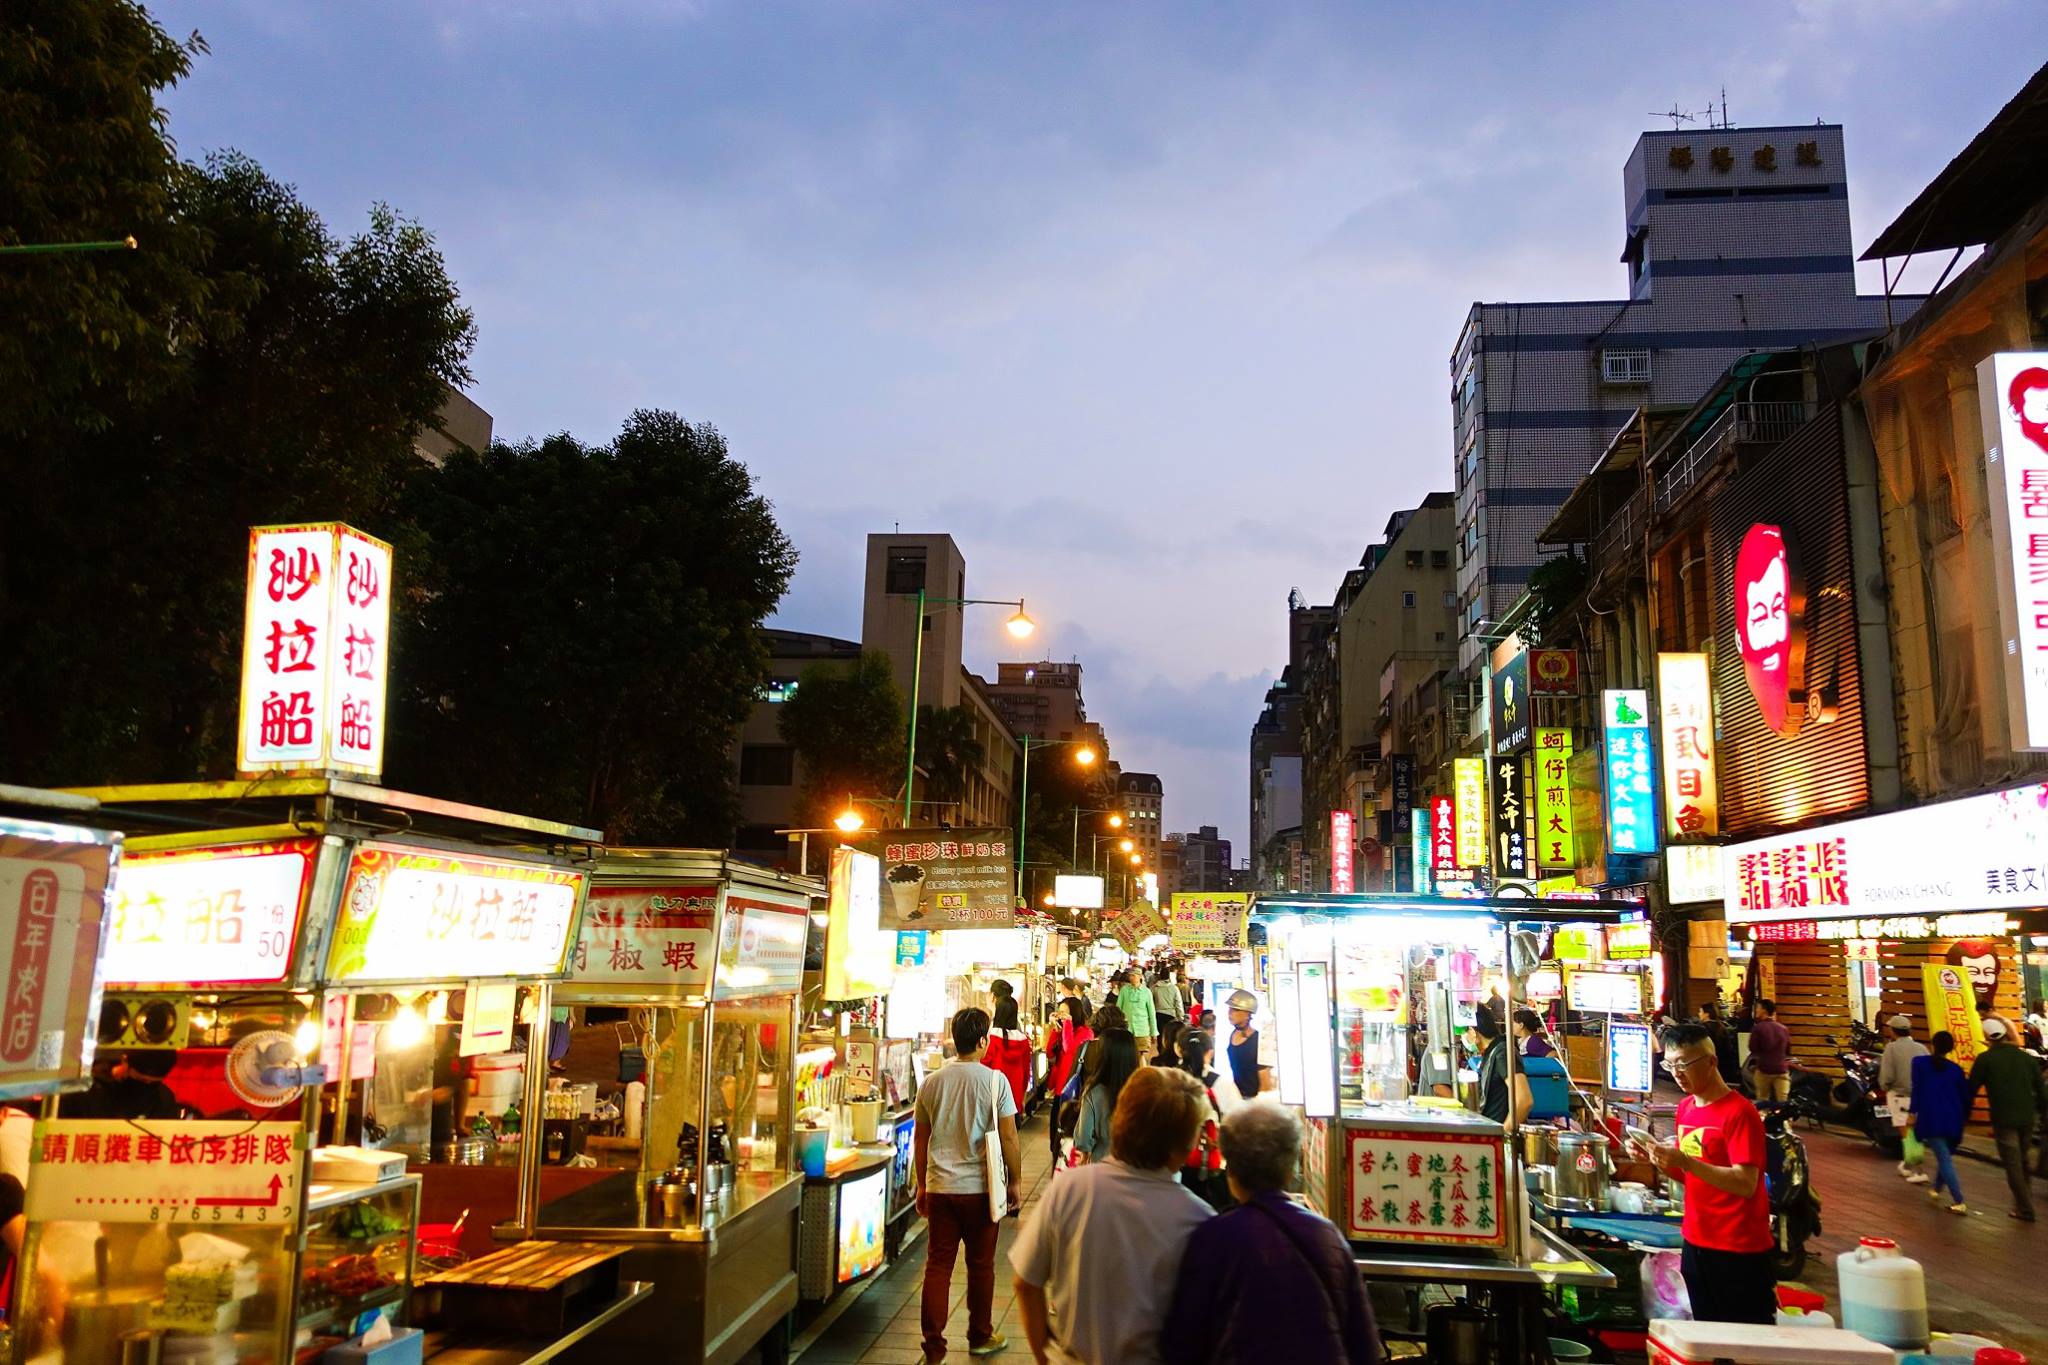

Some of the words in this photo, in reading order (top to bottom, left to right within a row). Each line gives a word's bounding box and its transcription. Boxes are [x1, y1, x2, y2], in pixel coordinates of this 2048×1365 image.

[260, 547, 320, 749] 沙拉船
[340, 551, 379, 752] 沙拉船
[1542, 732, 1568, 862] 蚵仔煎大王
[886, 841, 1006, 862] 蜂蜜珍珠鮮奶茶
[1736, 837, 1850, 910] 鬍鬚張
[257, 931, 286, 957] 50
[43, 1134, 292, 1165] 請順攤車依序排隊
[150, 1206, 159, 1220] 8
[170, 1206, 179, 1220] 7
[191, 1206, 200, 1220] 6
[211, 1206, 221, 1220] 5
[235, 1206, 245, 1220] 4
[257, 1206, 267, 1220] 3
[1359, 1150, 1378, 1223] 苦茶
[1381, 1151, 1401, 1224] 六一散
[1406, 1152, 1425, 1226] 蜜茶
[1427, 1153, 1447, 1227] 地骨露
[1450, 1154, 1470, 1228] 冬瓜茶
[1475, 1155, 1495, 1230] 青草茶
